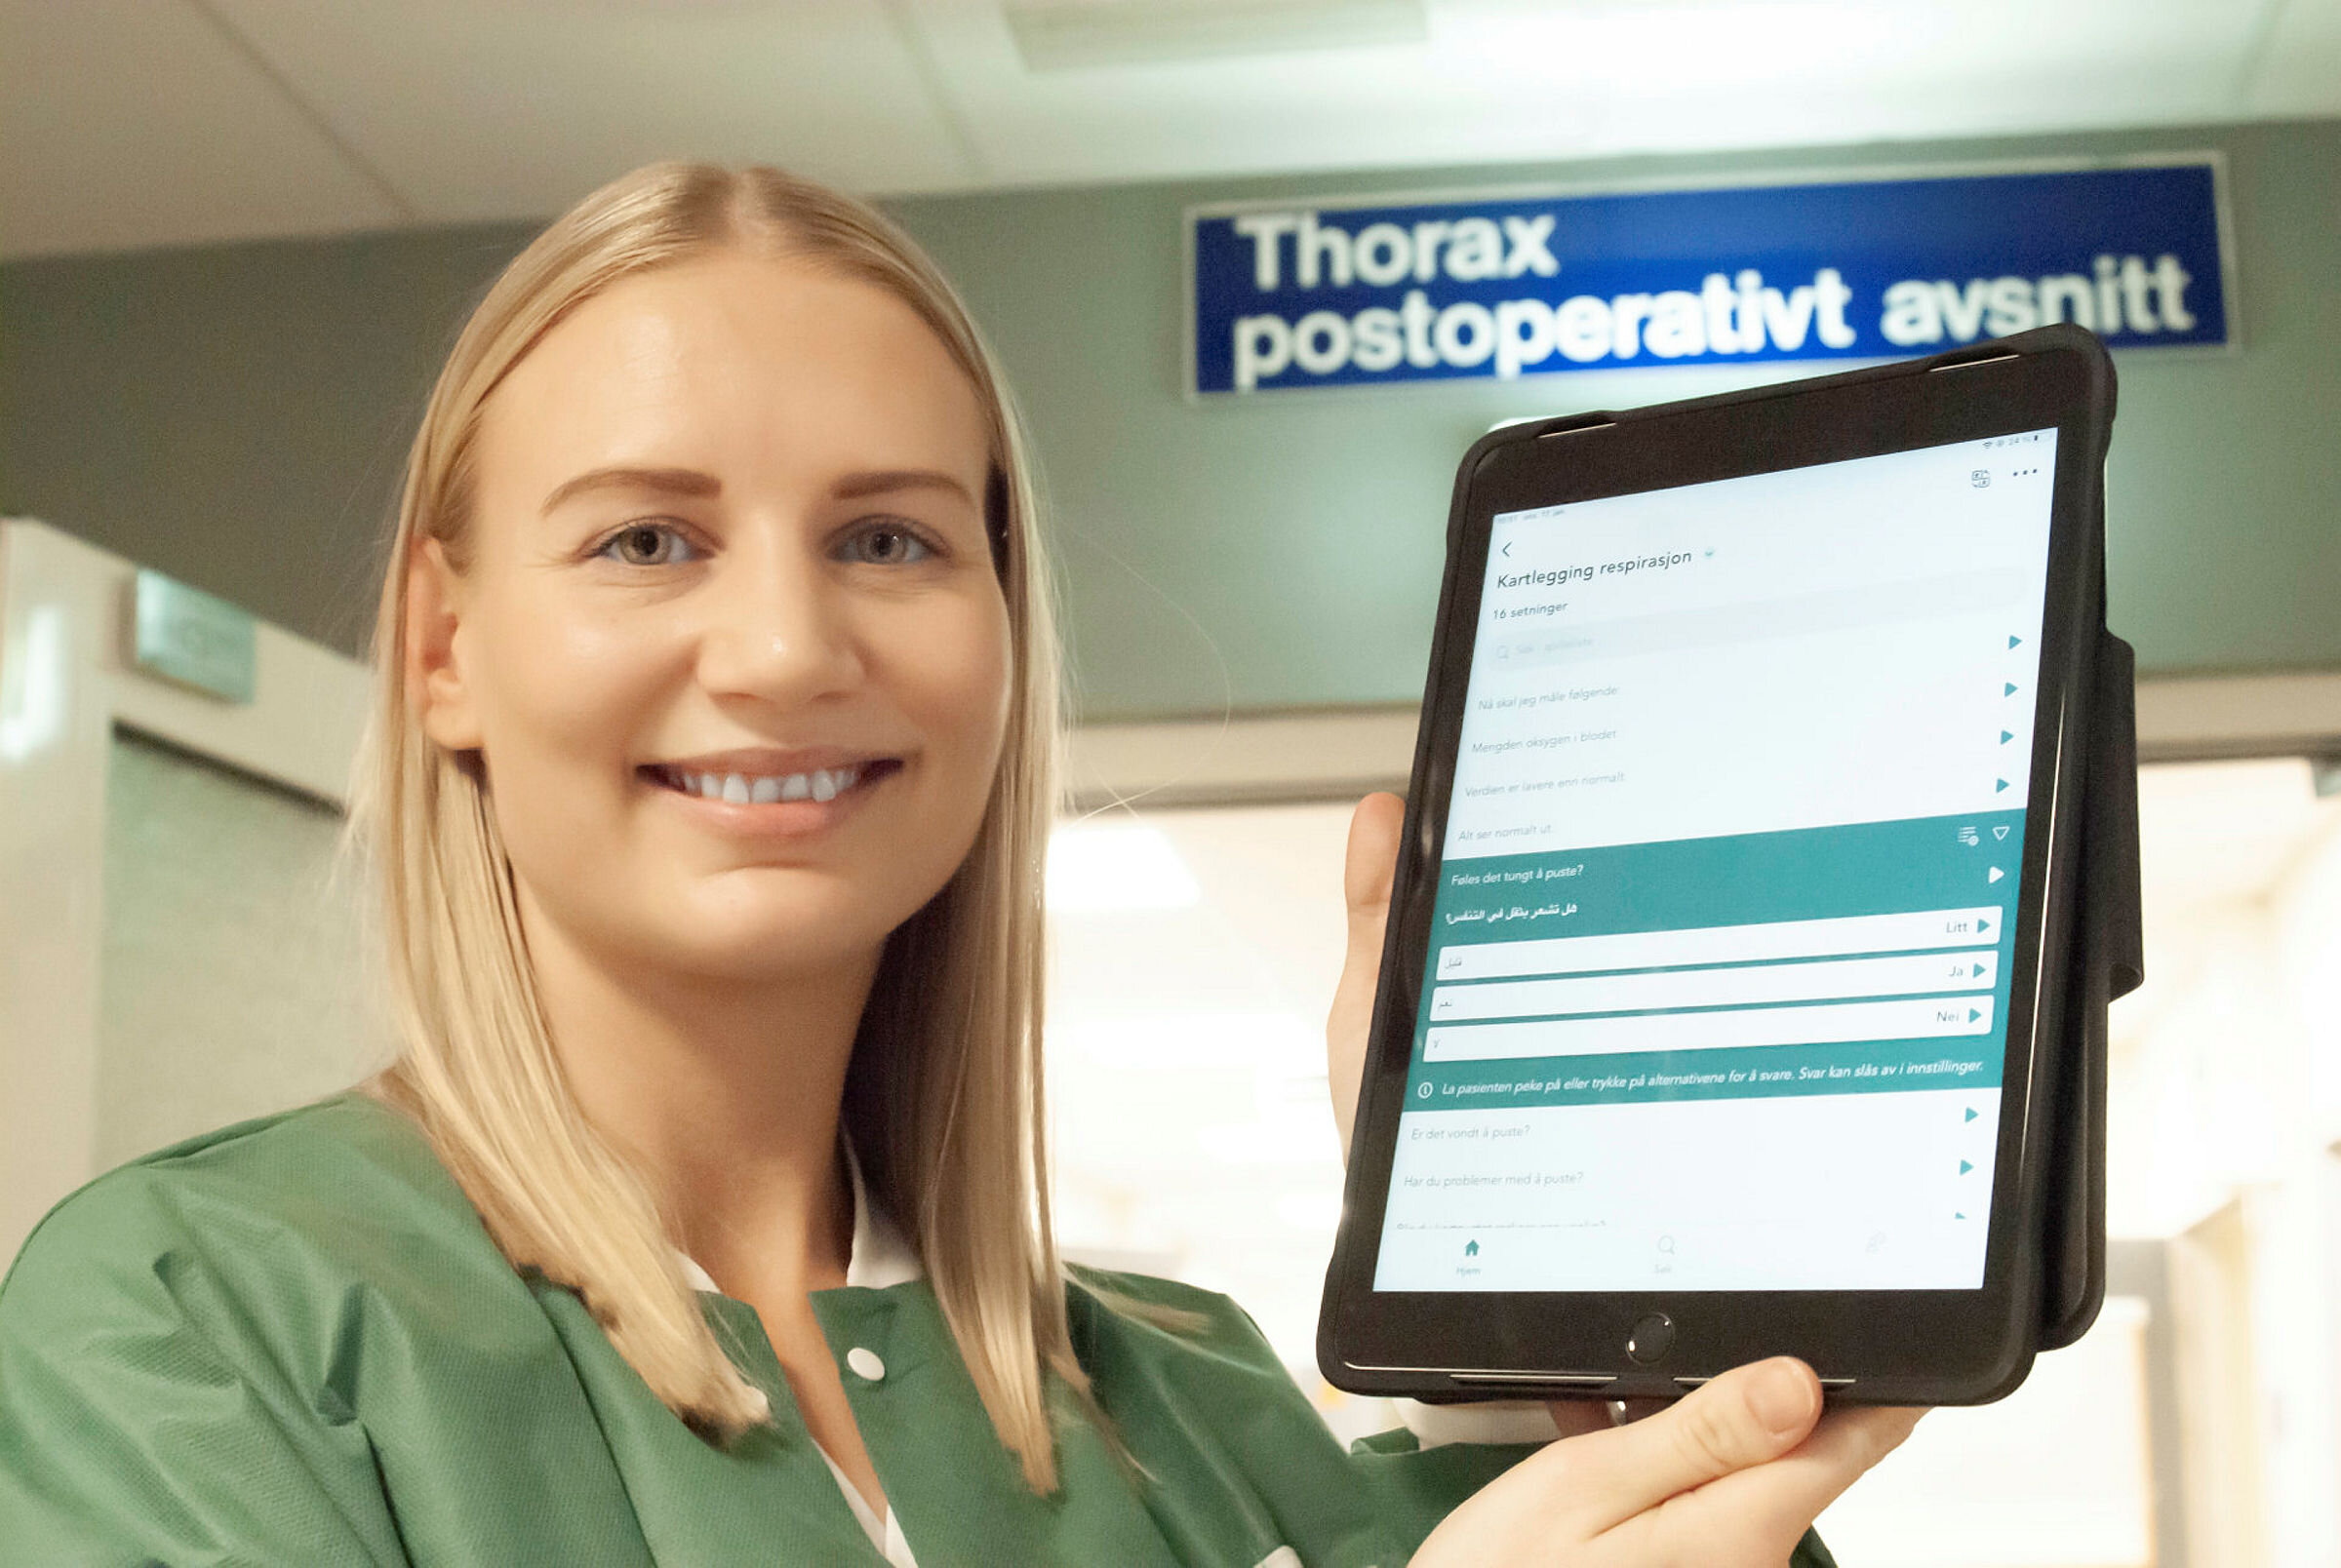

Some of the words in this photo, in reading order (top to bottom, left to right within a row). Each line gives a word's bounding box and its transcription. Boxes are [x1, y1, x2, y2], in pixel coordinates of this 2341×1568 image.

[1234, 213, 1559, 291] Thorax
[1234, 268, 1856, 394] postoperativt
[1880, 255, 2196, 347] avsnitt
[1497, 564, 1594, 589] Kartlegging
[1599, 551, 1692, 575] respirasjon
[1492, 609, 1507, 620] 16
[1510, 601, 1568, 618] setninger
[1496, 696, 1517, 710] skal
[1518, 695, 1536, 709] jeg
[1538, 690, 1566, 704] måle
[1472, 740, 1524, 755] Mengden
[1526, 733, 1571, 749] oksygen
[1580, 728, 1616, 742] blodet
[1465, 784, 1505, 798] Verdien
[1508, 783, 1521, 794] er
[1522, 779, 1554, 792] lavere
[1557, 777, 1578, 789] enn
[1458, 830, 1474, 842] Alt
[1476, 829, 1491, 841] ser
[1495, 824, 1537, 838] normalt
[1450, 874, 1481, 886] Føles
[1483, 872, 1501, 883] det
[1504, 870, 1533, 883] tungt
[1536, 867, 1543, 879] å
[1545, 864, 1584, 882] puste?
[1488, 907, 1503, 923] في
[1530, 903, 1560, 920] تشعر
[1561, 902, 1577, 917] هل
[1946, 921, 1967, 933] Litt
[1949, 965, 1964, 977] Ja
[1936, 1010, 1960, 1023] Nei
[1442, 1083, 1455, 1095] La
[1456, 1081, 1512, 1098] pasienten
[1514, 1080, 1543, 1096] peke
[1545, 1078, 1561, 1094] på
[1564, 1077, 1589, 1090] eller
[1592, 1076, 1626, 1093] trykke
[1628, 1075, 1646, 1091] på
[1648, 1071, 1725, 1087] alternativene
[1728, 1070, 1745, 1083] for
[1748, 1069, 1757, 1082] å
[1759, 1070, 1795, 1082] svare.
[1798, 1066, 1825, 1080] Svar
[1828, 1064, 1851, 1078] kan
[1854, 1063, 1879, 1078] slås
[1881, 1066, 1896, 1077] av
[1906, 1059, 1983, 1076] innstillinger.
[1411, 1128, 1424, 1141] Er
[1426, 1127, 1446, 1140] det
[1448, 1125, 1480, 1139] vondt
[1482, 1125, 1489, 1138] å
[1491, 1124, 1530, 1140] puste?
[1405, 1176, 1423, 1188] Har
[1426, 1175, 1441, 1187] du
[1444, 1173, 1502, 1189] problemer
[1505, 1172, 1531, 1186] med
[1533, 1173, 1541, 1185] å
[1543, 1171, 1584, 1187] puste?
